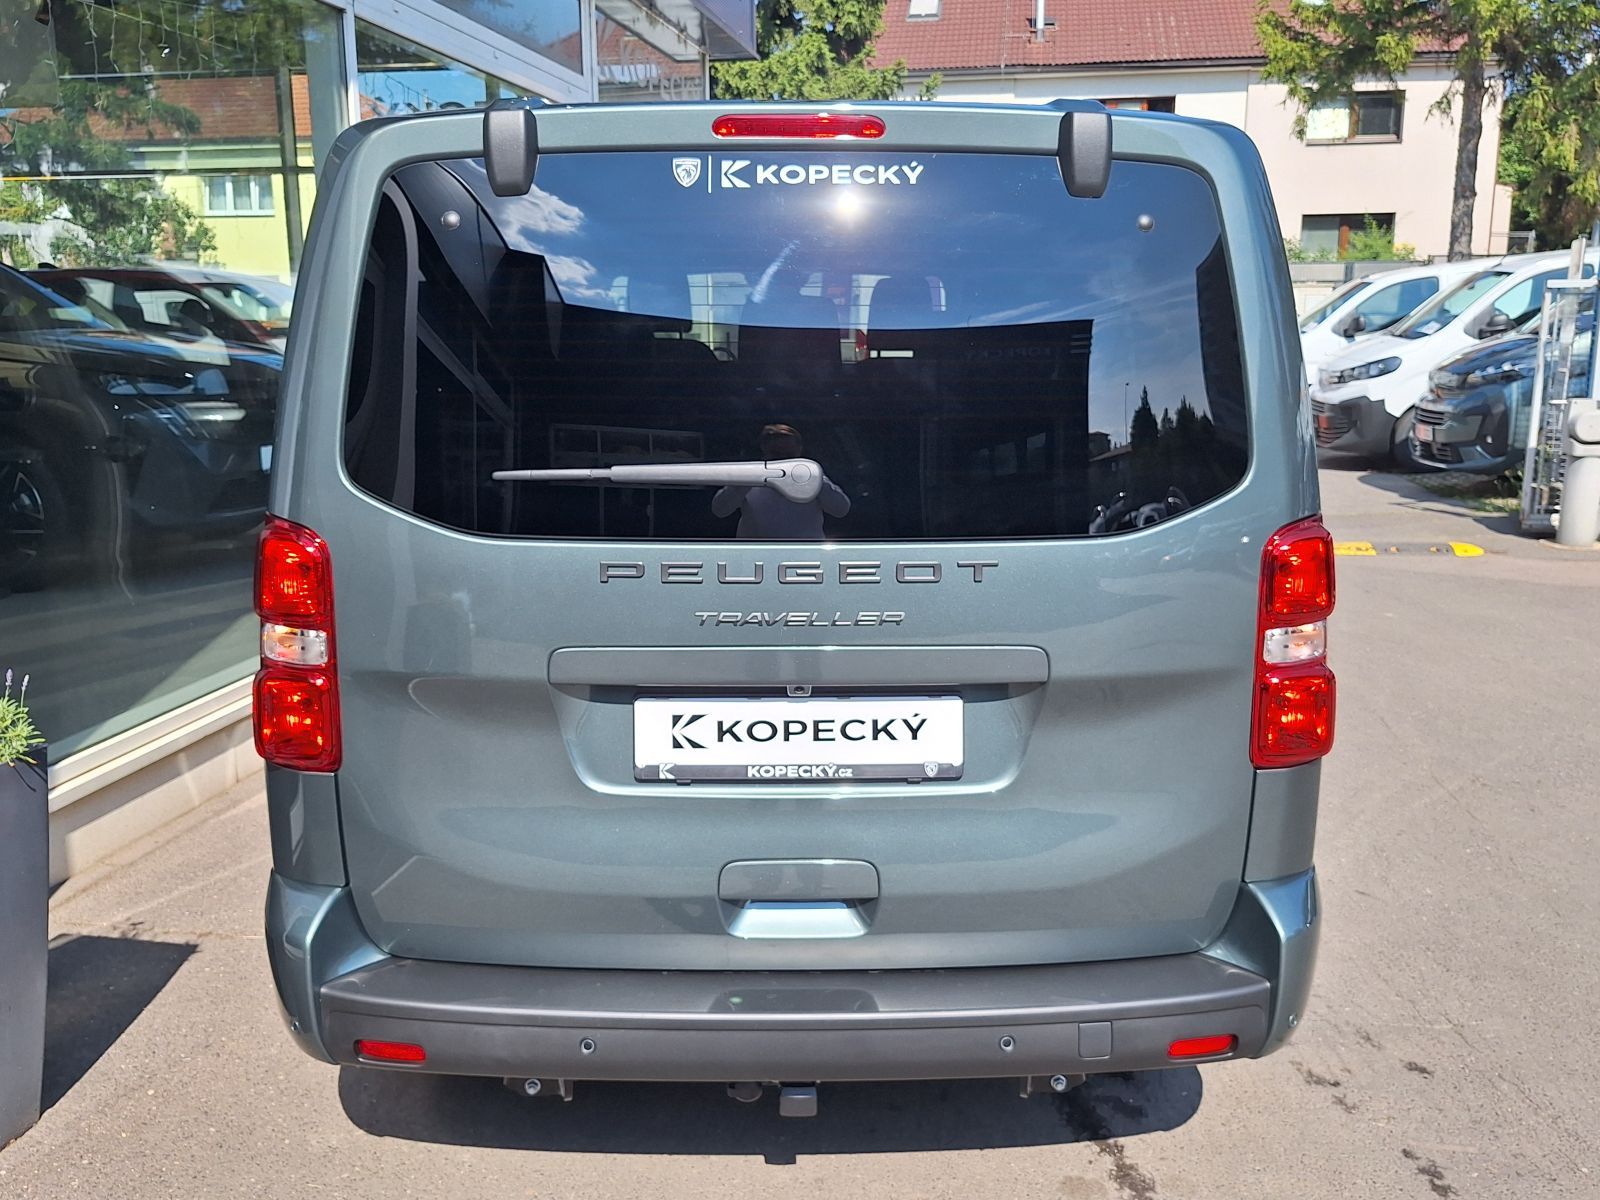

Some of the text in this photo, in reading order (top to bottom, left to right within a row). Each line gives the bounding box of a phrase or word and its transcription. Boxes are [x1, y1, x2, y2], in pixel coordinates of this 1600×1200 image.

[756, 161, 923, 184] KOPECKÝ
[600, 560, 999, 583] PEUGEOT
[694, 611, 905, 627] TRAVELLER
[717, 712, 928, 742] KOPECKÝ
[747, 762, 852, 778] KOPECKÝ.cz
